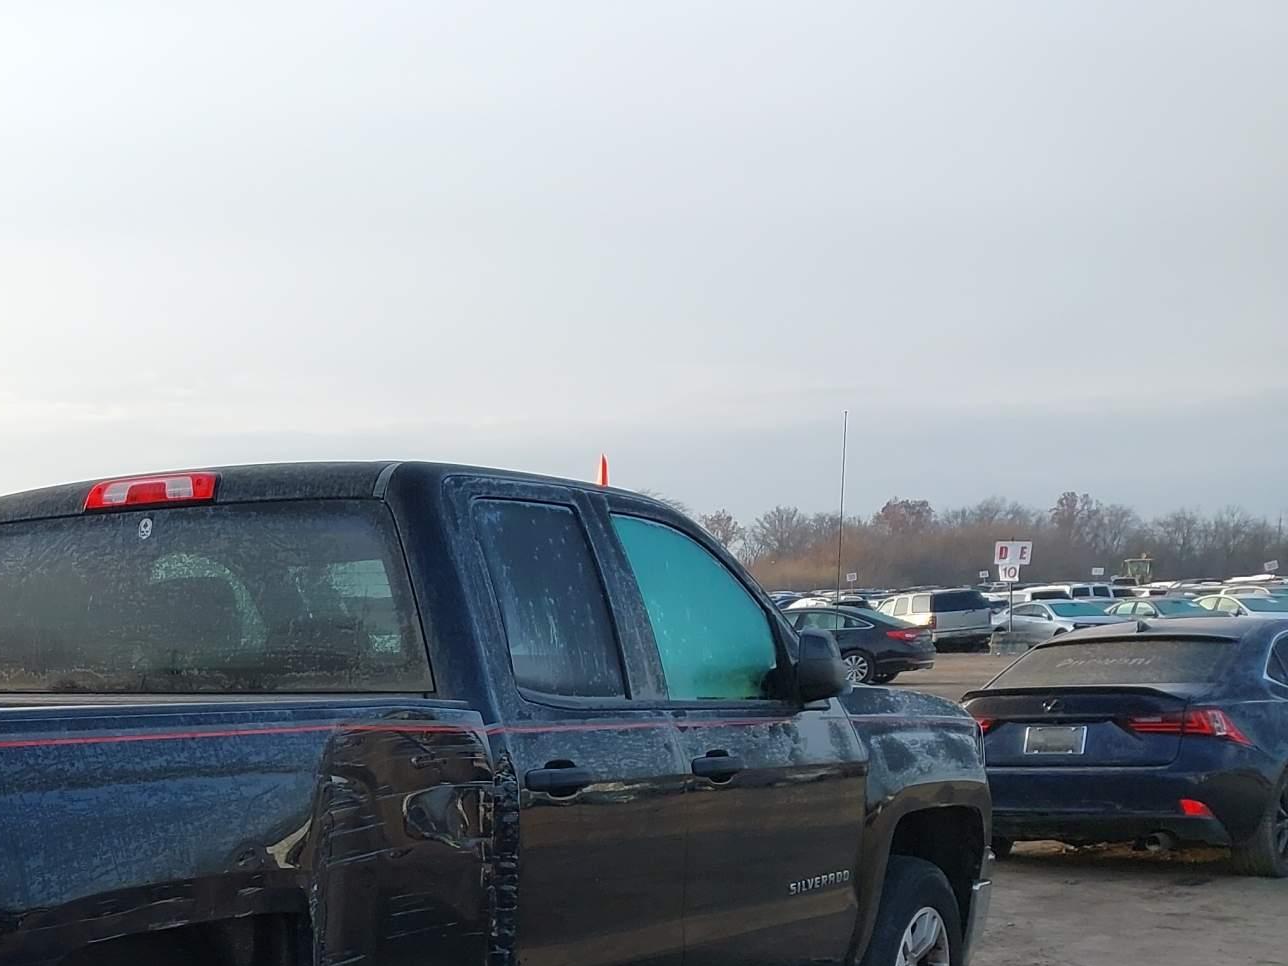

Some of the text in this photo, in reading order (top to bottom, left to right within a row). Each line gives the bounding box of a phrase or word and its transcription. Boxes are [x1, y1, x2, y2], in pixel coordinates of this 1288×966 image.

[999, 546, 1027, 560] D E
[1002, 566, 1017, 578] 10
[789, 869, 850, 896] SILVERADO
